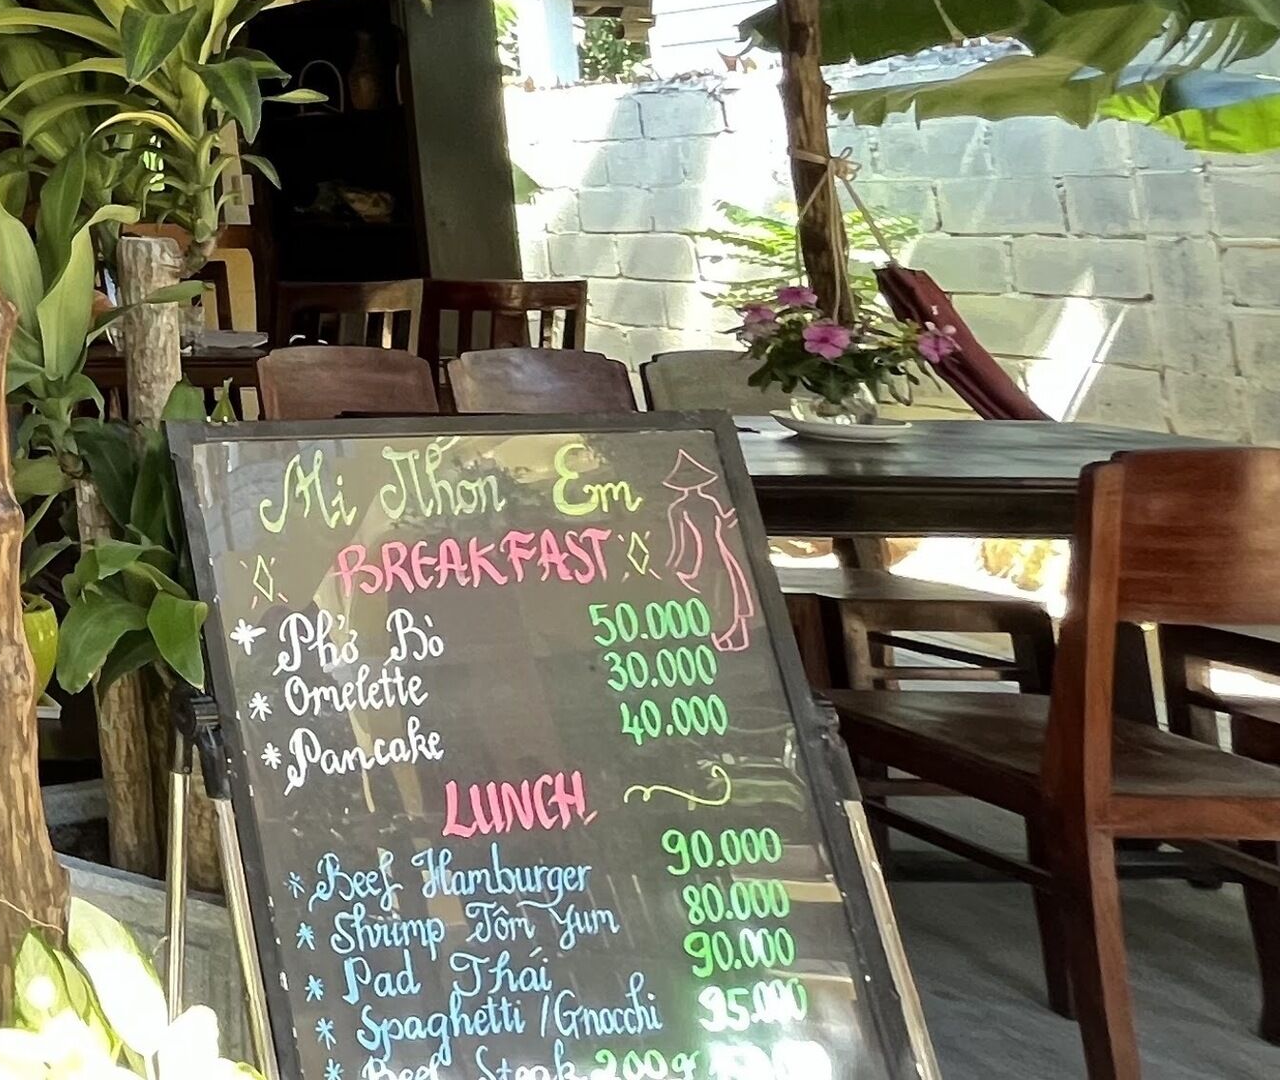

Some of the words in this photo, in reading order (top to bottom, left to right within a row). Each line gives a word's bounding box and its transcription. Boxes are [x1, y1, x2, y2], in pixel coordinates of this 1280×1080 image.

[551, 443, 643, 517] Em
[331, 527, 613, 598] BREAKFAST
[272, 608, 360, 677] Phở
[382, 607, 445, 666] Bò
[588, 597, 712, 647] 50.000
[284, 663, 429, 717] Omelette
[603, 644, 718, 692] 30.000
[619, 693, 728, 746] 40.000
[283, 715, 445, 796] Pancake
[442, 770, 587, 838] LUNCH
[308, 851, 404, 912] Beef
[410, 842, 592, 908] Hamburger
[661, 827, 782, 876] 90.000
[682, 878, 791, 926] 80.000
[330, 904, 445, 962] Shrimp
[683, 927, 796, 979] 90.000
[342, 949, 422, 1005] Pad
[449, 946, 554, 997] Thái
[356, 990, 526, 1067] Spaghetti
